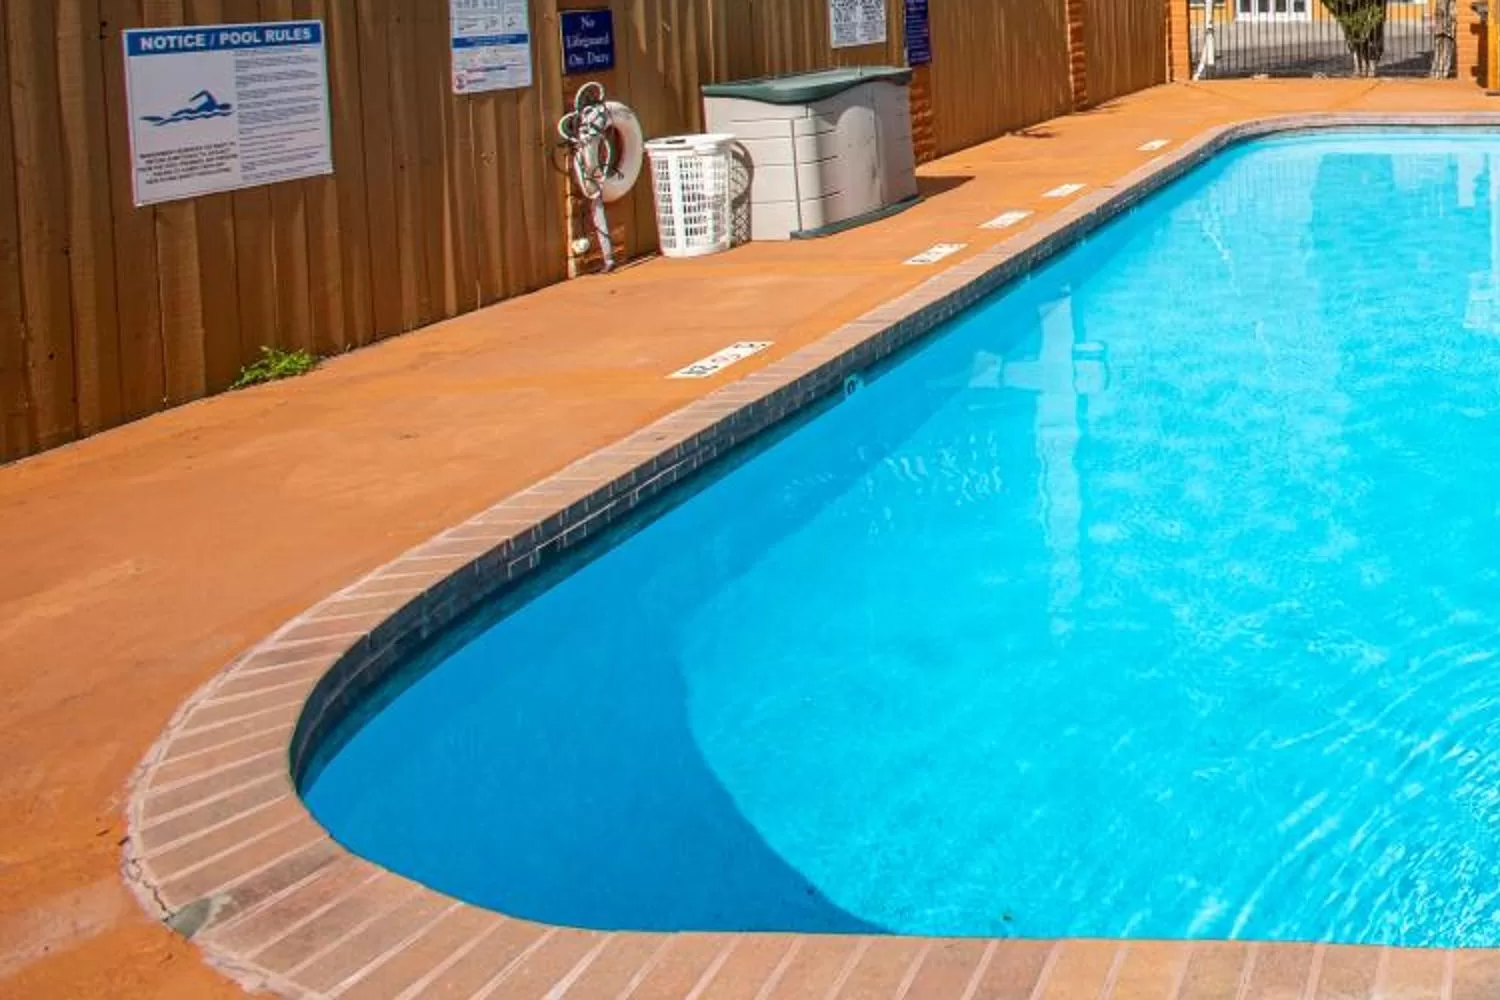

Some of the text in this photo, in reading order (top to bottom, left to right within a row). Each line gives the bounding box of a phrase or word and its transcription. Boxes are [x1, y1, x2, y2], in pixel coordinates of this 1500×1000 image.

[580, 15, 595, 29] No
[140, 33, 206, 50] NOTICE
[219, 31, 261, 45] POOL
[265, 27, 312, 42] RULES
[566, 32, 609, 48] Lifeguard
[569, 51, 609, 66] On Duty
